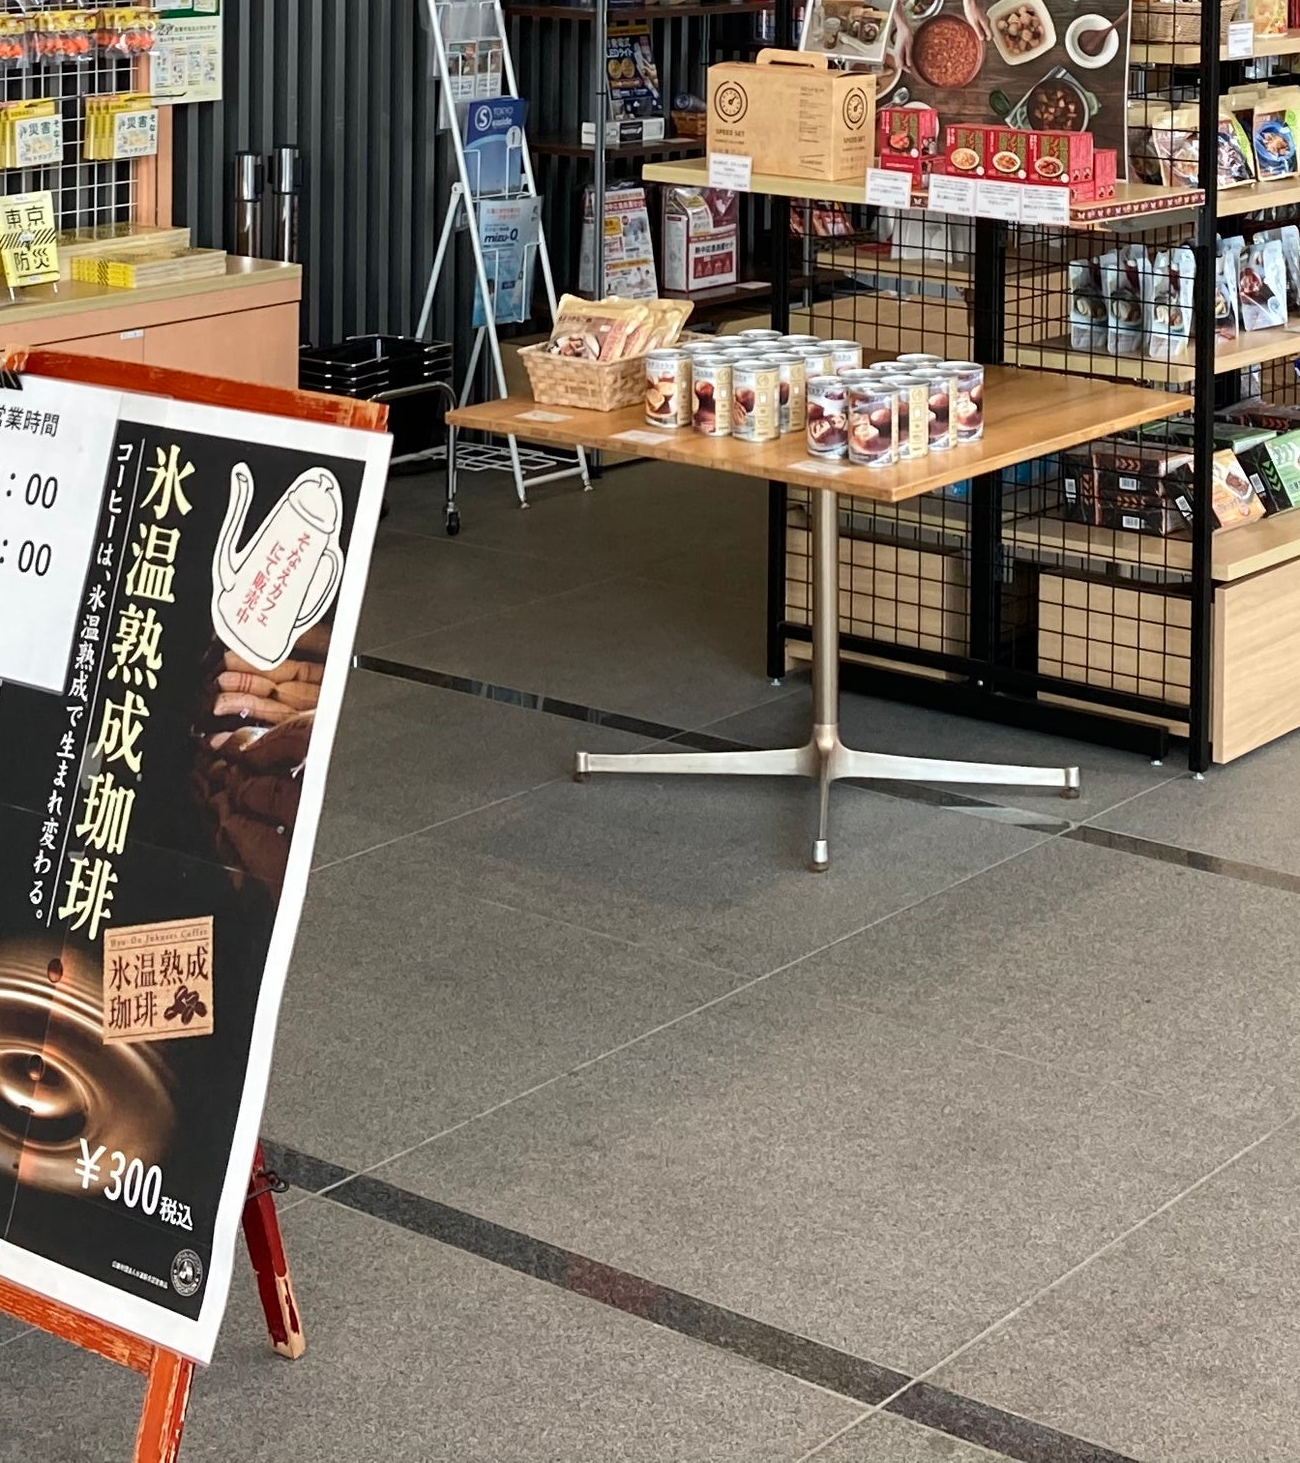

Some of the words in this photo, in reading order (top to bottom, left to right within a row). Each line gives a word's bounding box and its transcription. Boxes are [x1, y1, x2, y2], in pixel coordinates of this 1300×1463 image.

[4, 205, 46, 230] 東京
[13, 248, 51, 273] 防災
[234, 541, 284, 626] にて販売中
[254, 531, 312, 629] そなえカフェ
[57, 443, 199, 942] 氷温熟成珈琲
[107, 943, 211, 991] 氷温熟成
[107, 991, 159, 1030] 珈琲
[74, 1137, 163, 1216] ¥300
[160, 1195, 194, 1232] 税込
